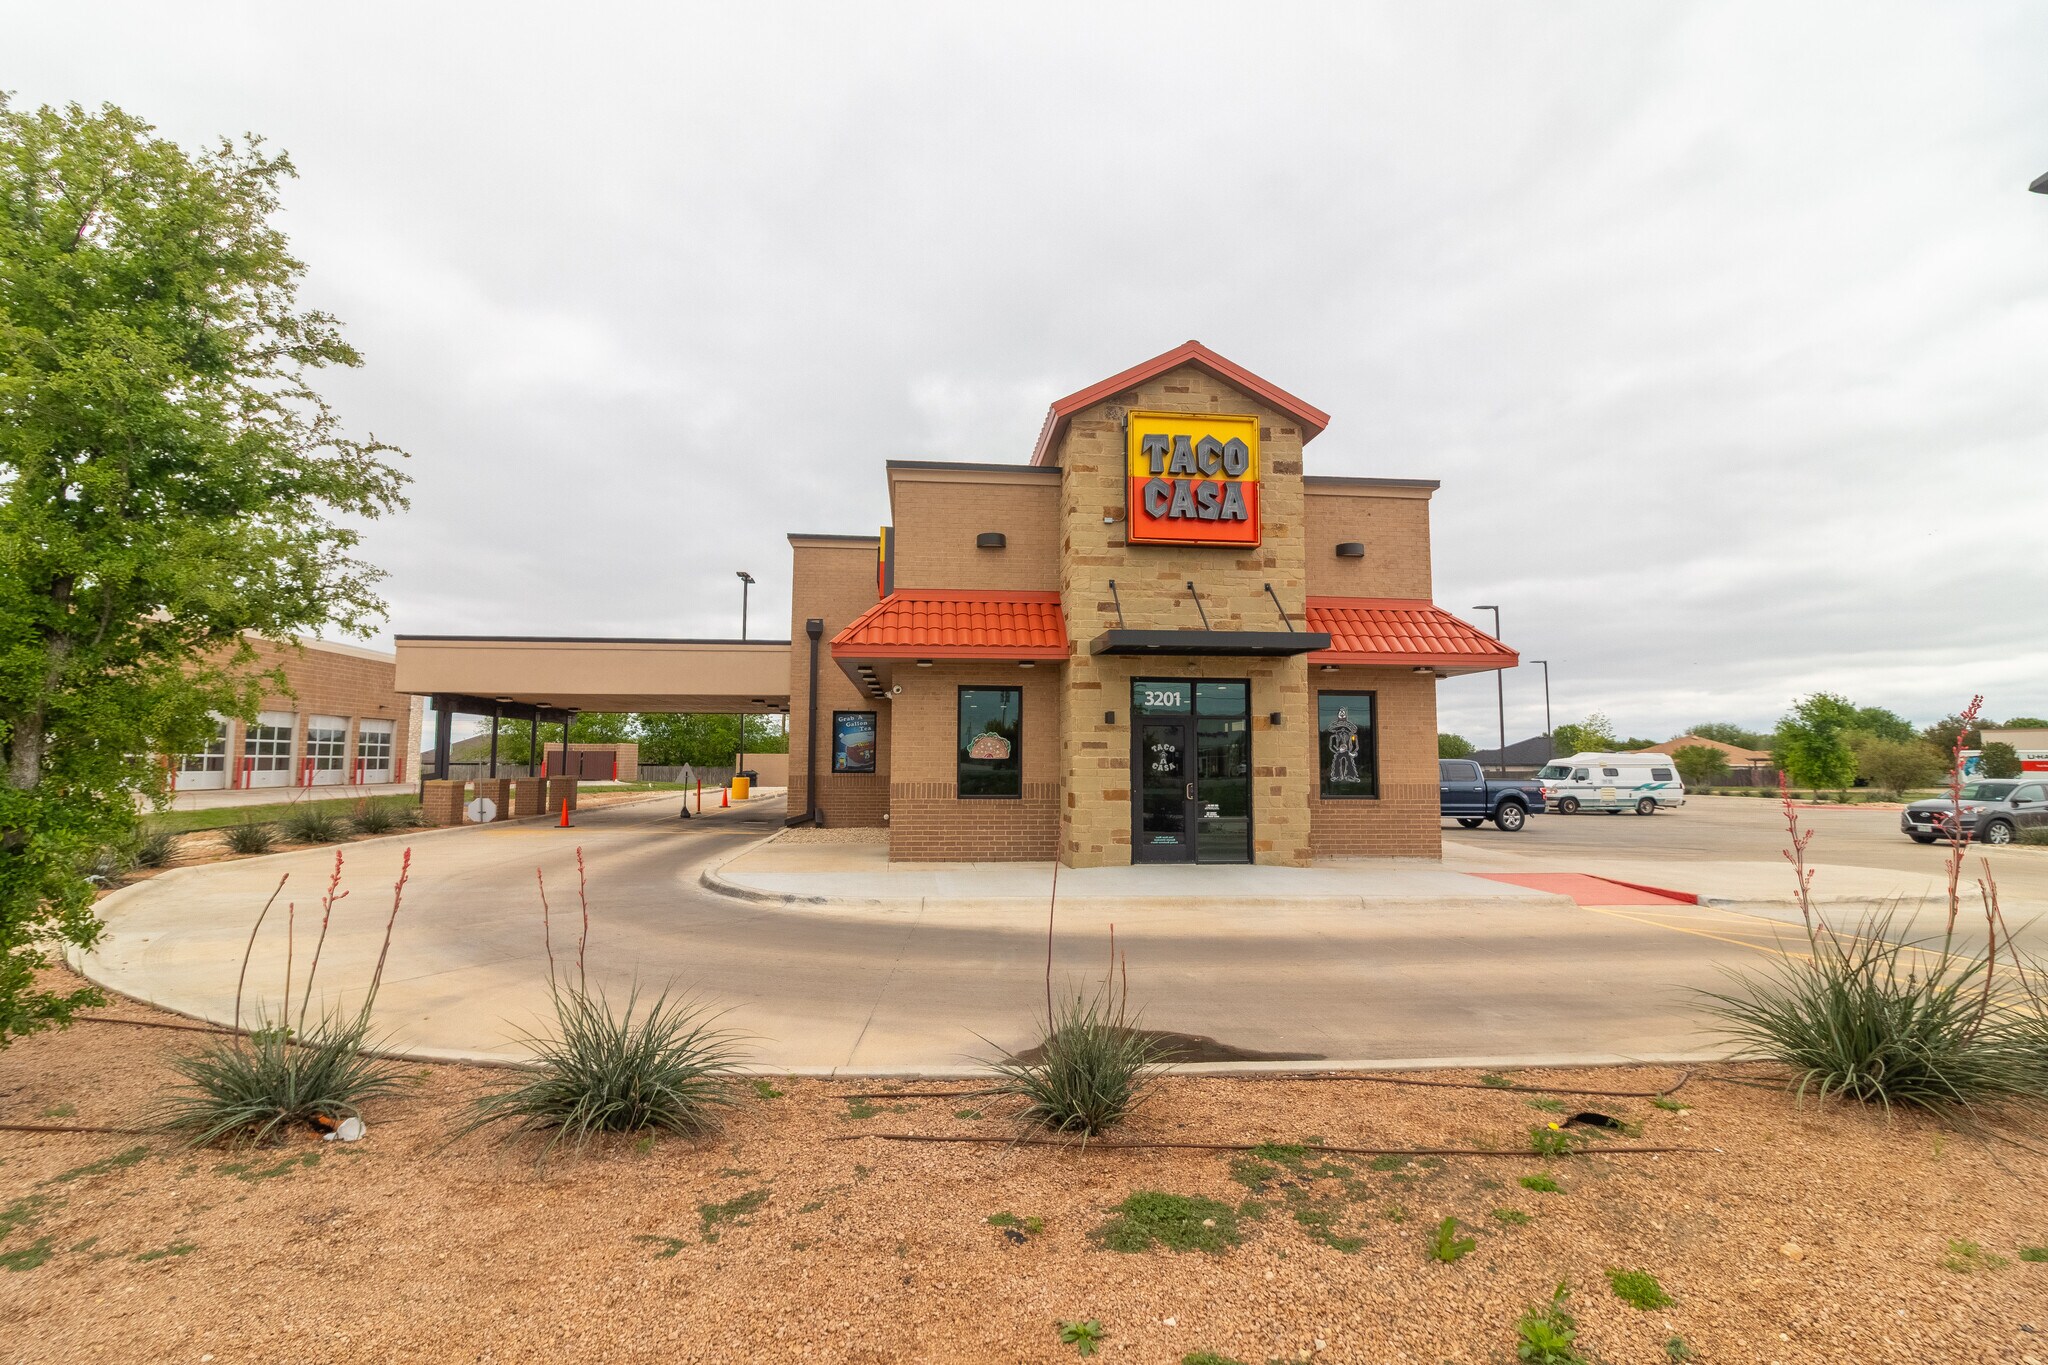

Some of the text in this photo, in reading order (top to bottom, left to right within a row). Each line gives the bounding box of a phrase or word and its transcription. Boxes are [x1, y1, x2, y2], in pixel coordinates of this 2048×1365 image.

[1141, 434, 1249, 477] TACO
[1143, 477, 1248, 521] CASA
[1144, 691, 1181, 707] 3201
[1151, 743, 1176, 753] TACO
[1152, 762, 1176, 772] CASA
